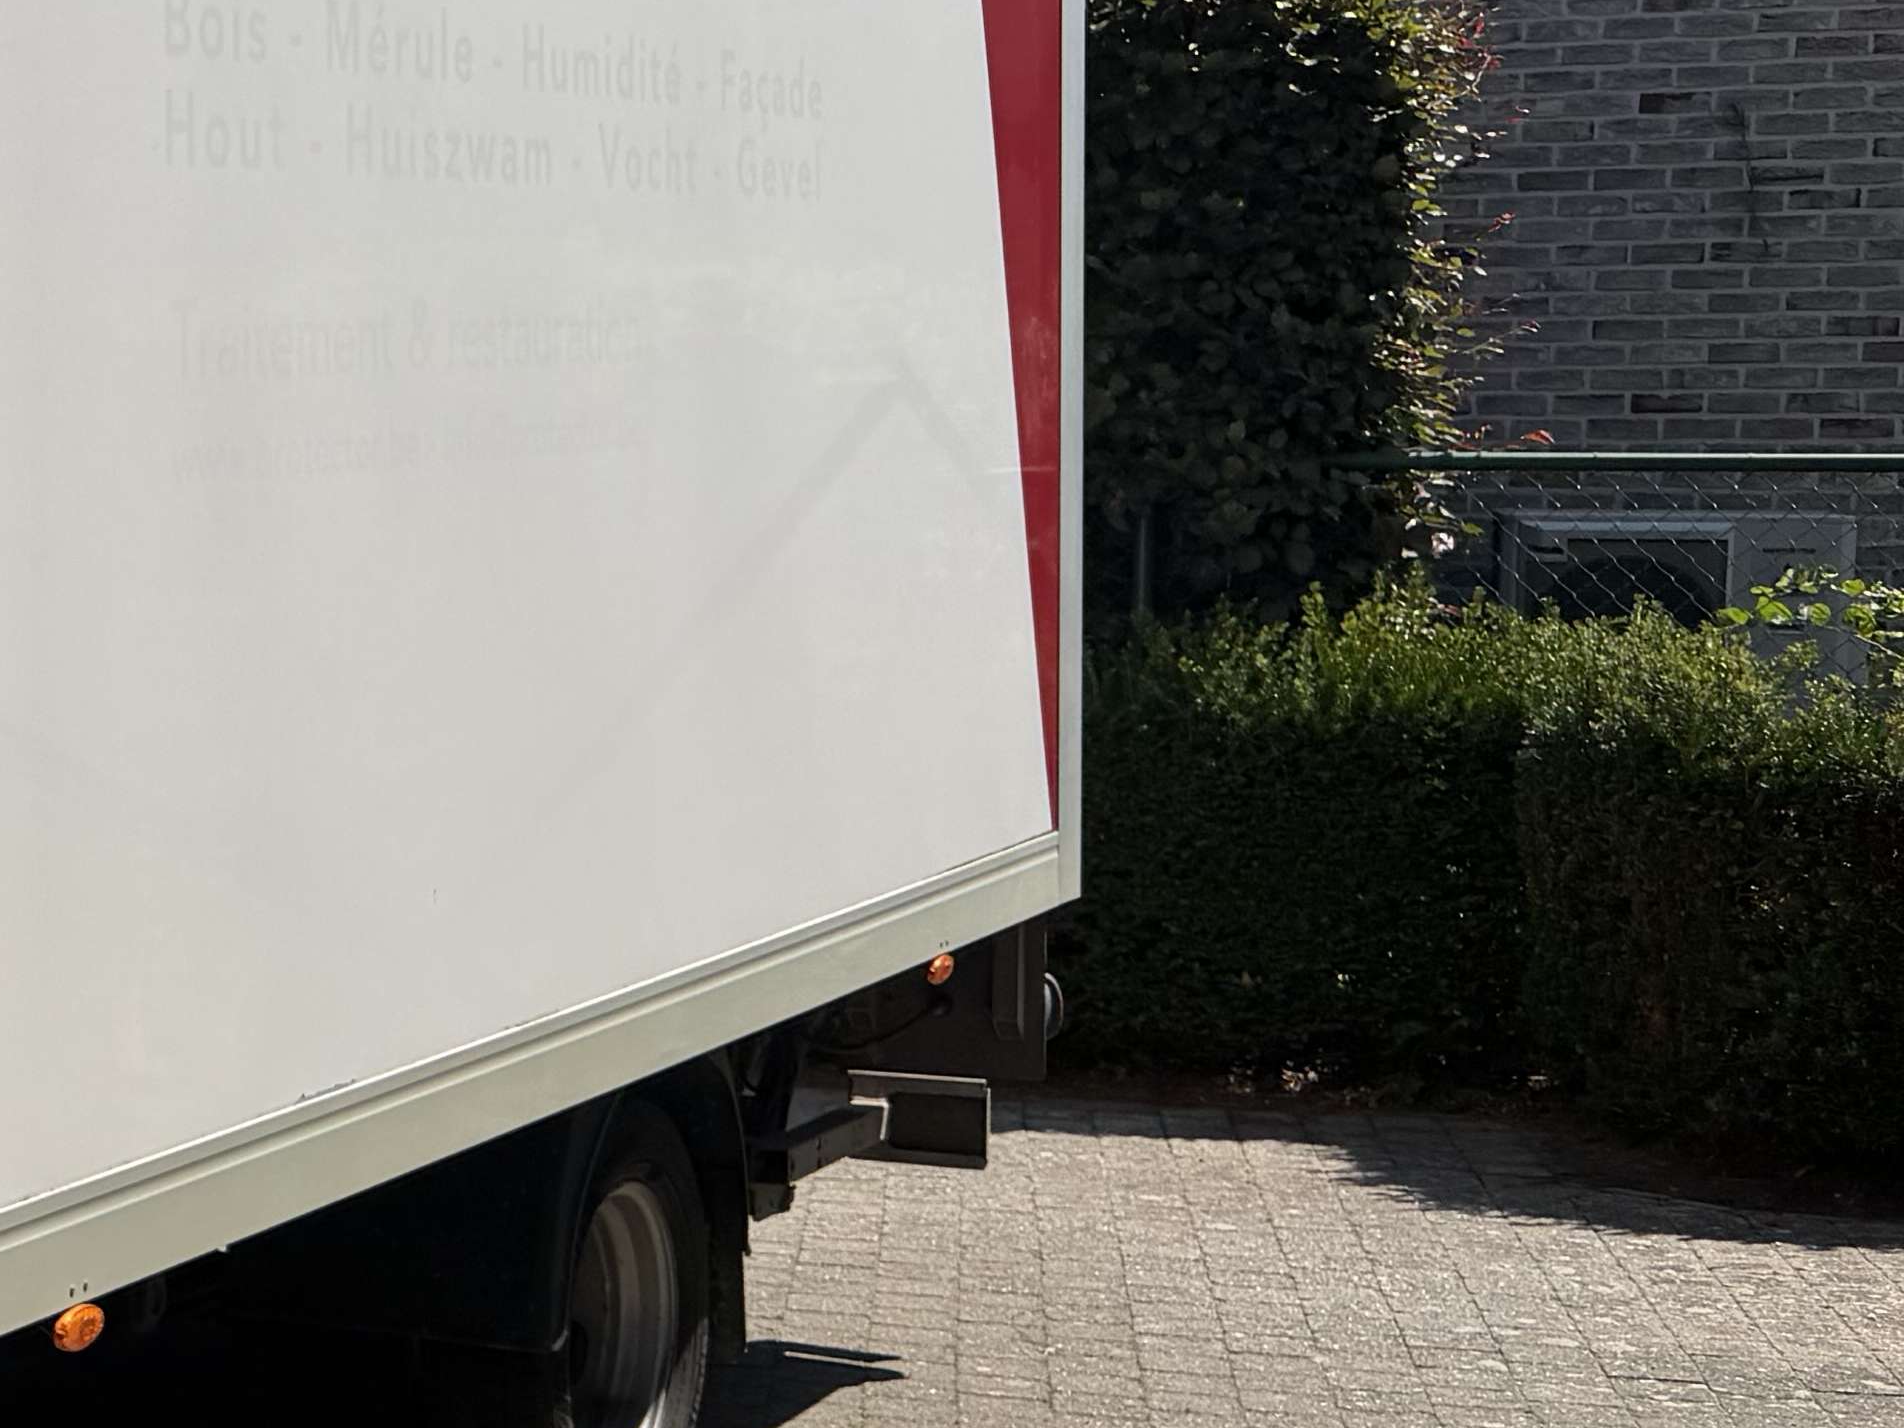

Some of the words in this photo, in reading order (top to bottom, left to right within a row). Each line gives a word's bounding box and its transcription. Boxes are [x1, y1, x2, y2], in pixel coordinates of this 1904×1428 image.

[522, 20, 682, 107] Humidité
[719, 49, 823, 134] Façade
[163, 89, 288, 172] Hout
[345, 102, 554, 186] Huiszwam
[599, 120, 698, 198] Vocht
[736, 137, 823, 204] Gevel
